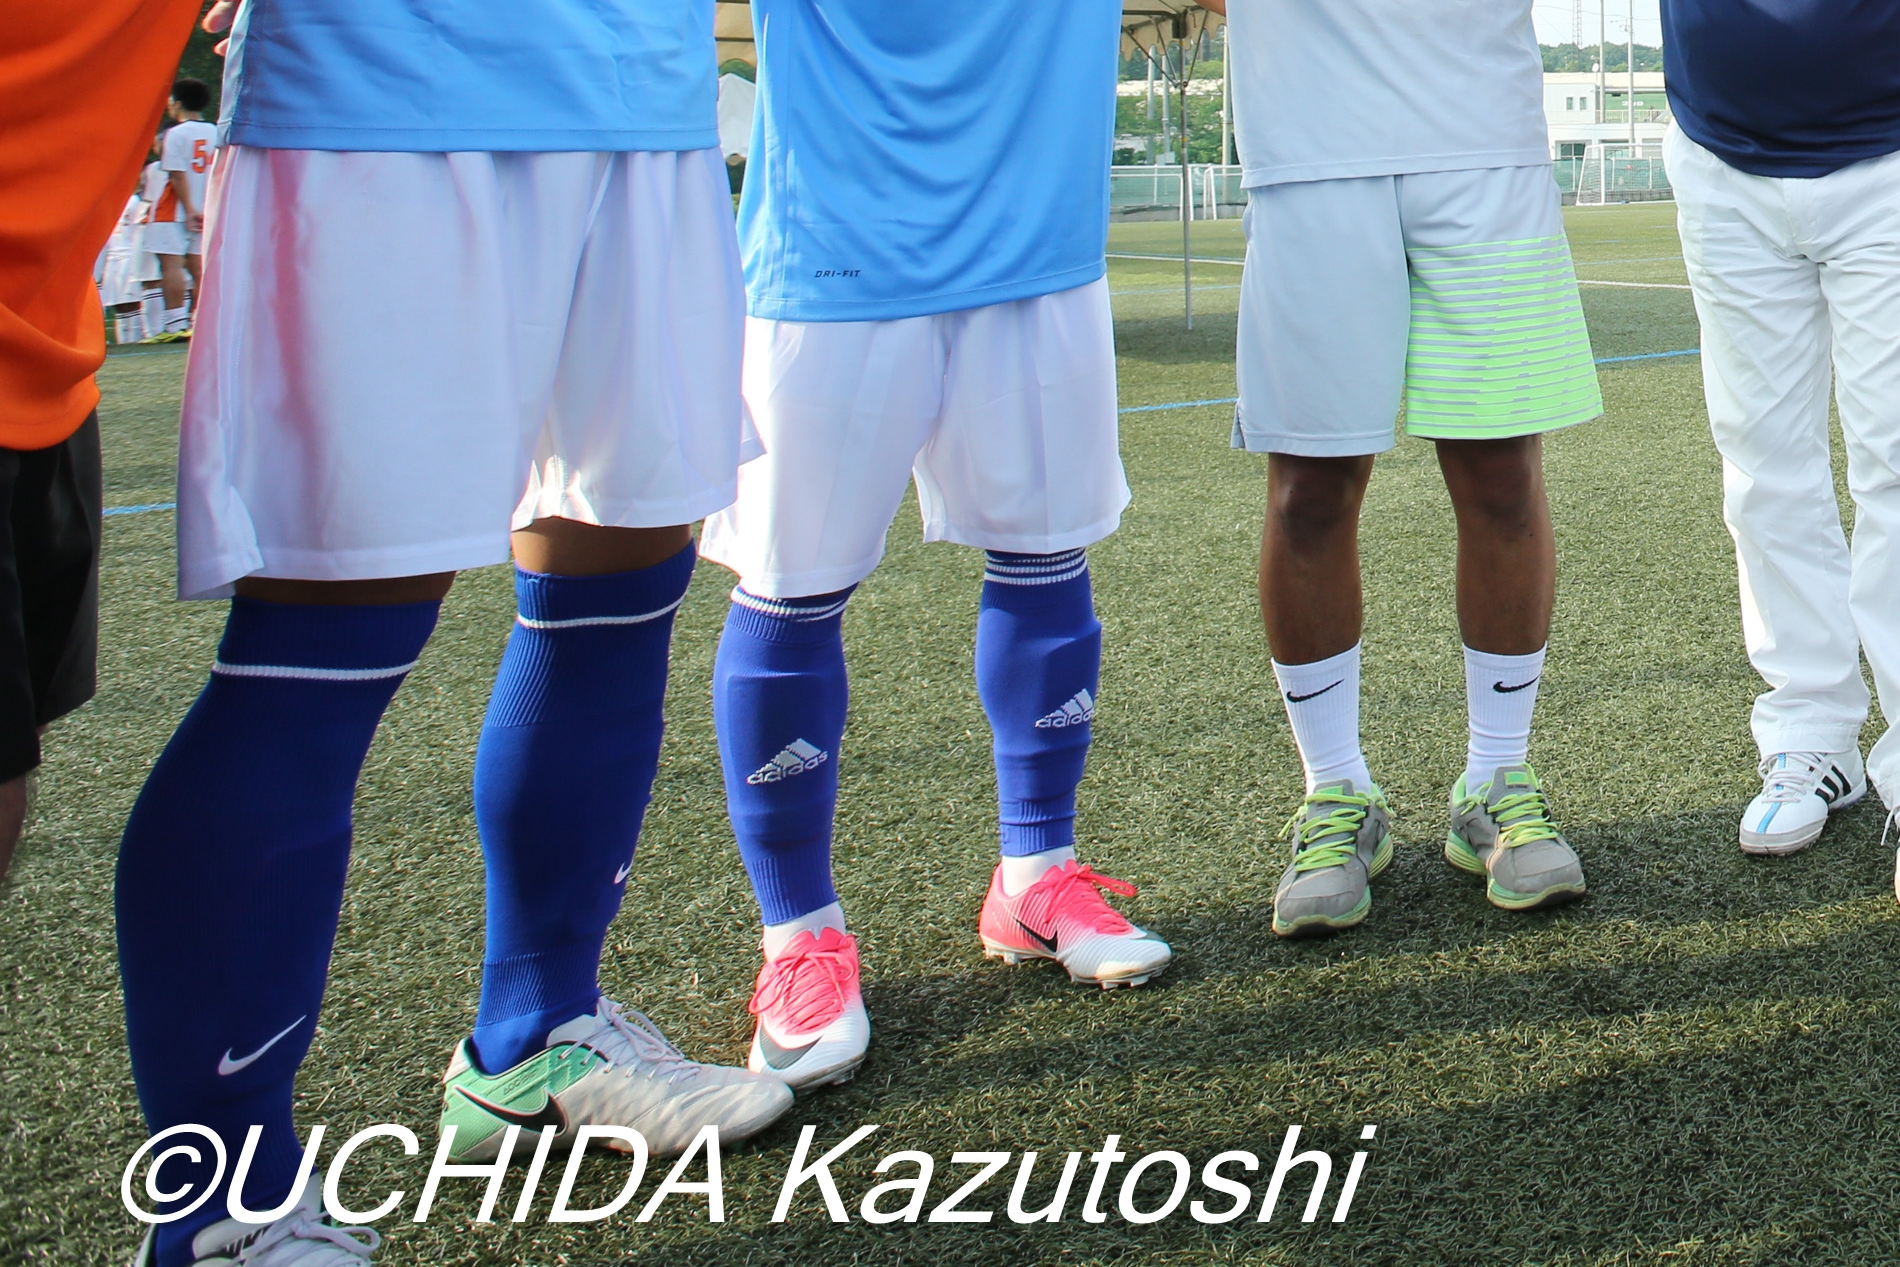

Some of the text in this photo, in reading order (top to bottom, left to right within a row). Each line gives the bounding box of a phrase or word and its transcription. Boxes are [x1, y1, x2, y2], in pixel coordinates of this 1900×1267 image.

[814, 269, 861, 278] DRI-FIT
[1034, 708, 1095, 728] adida
[746, 750, 828, 785] adidas
